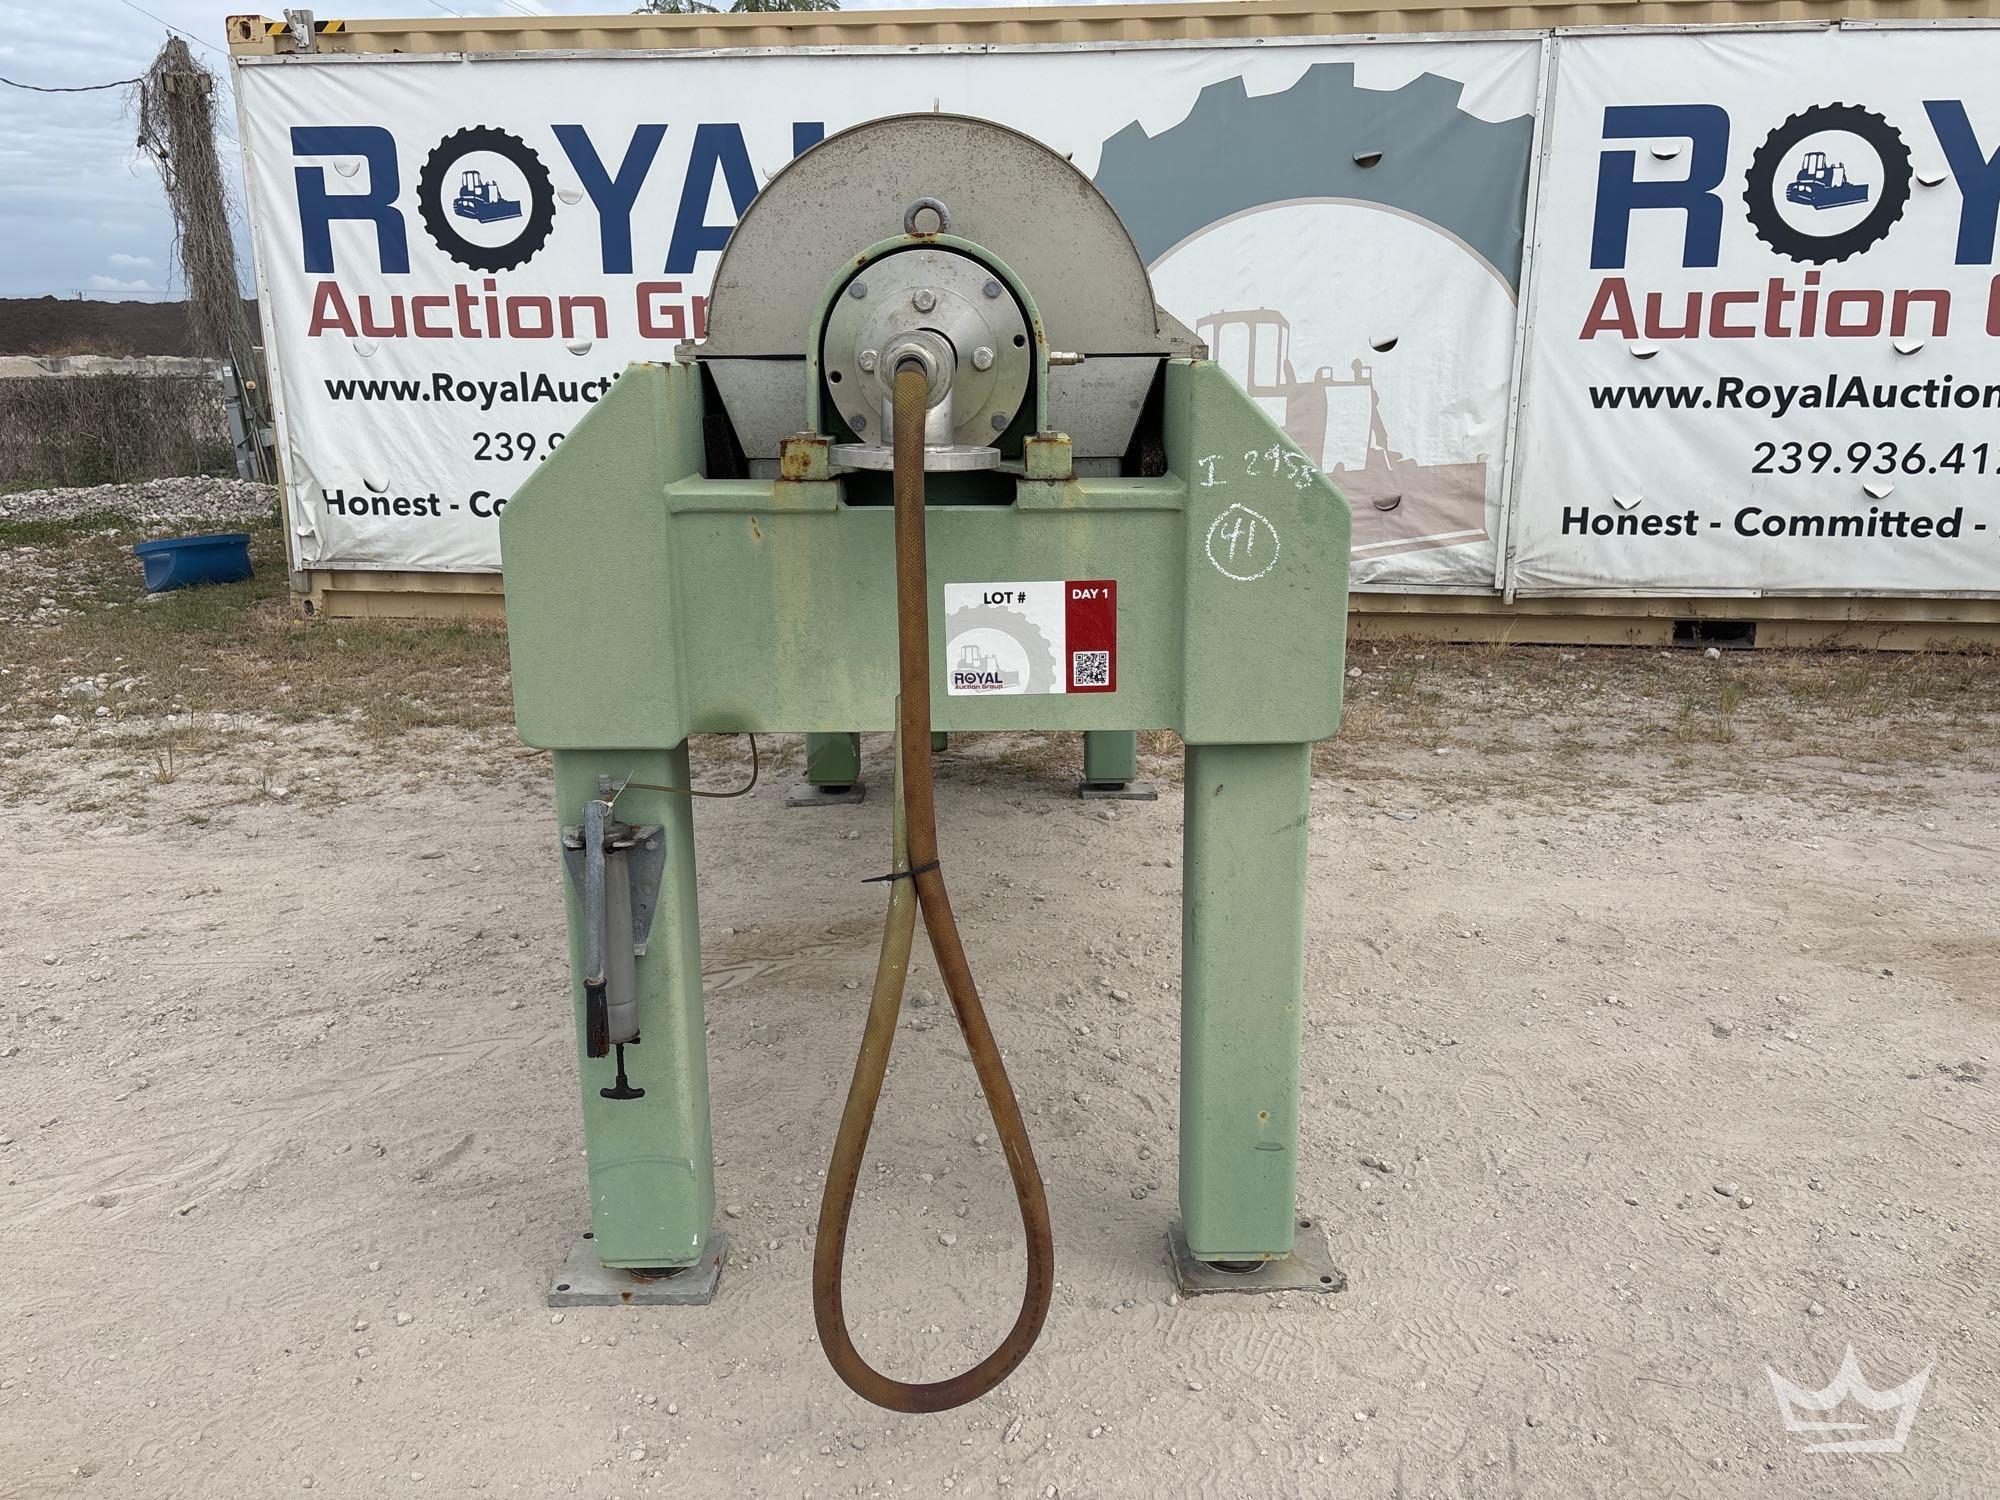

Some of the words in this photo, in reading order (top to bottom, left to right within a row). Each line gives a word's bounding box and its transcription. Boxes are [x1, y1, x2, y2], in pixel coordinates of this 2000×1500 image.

[290, 122, 824, 274] ROYA
[308, 278, 608, 338] Auction
[1579, 271, 1951, 340] Auction
[325, 371, 620, 411] www.RoyalAuct
[1752, 442, 2000, 475] 239.936.41
[322, 489, 441, 516] Honest
[1562, 506, 1699, 536] Honest
[1734, 506, 1964, 538] Committed
[984, 592, 1013, 604] LOT
[1017, 591, 1026, 604] #
[1072, 588, 1099, 599] DAY
[1102, 588, 1108, 599] 1
[954, 672, 1003, 684] ROYAL
